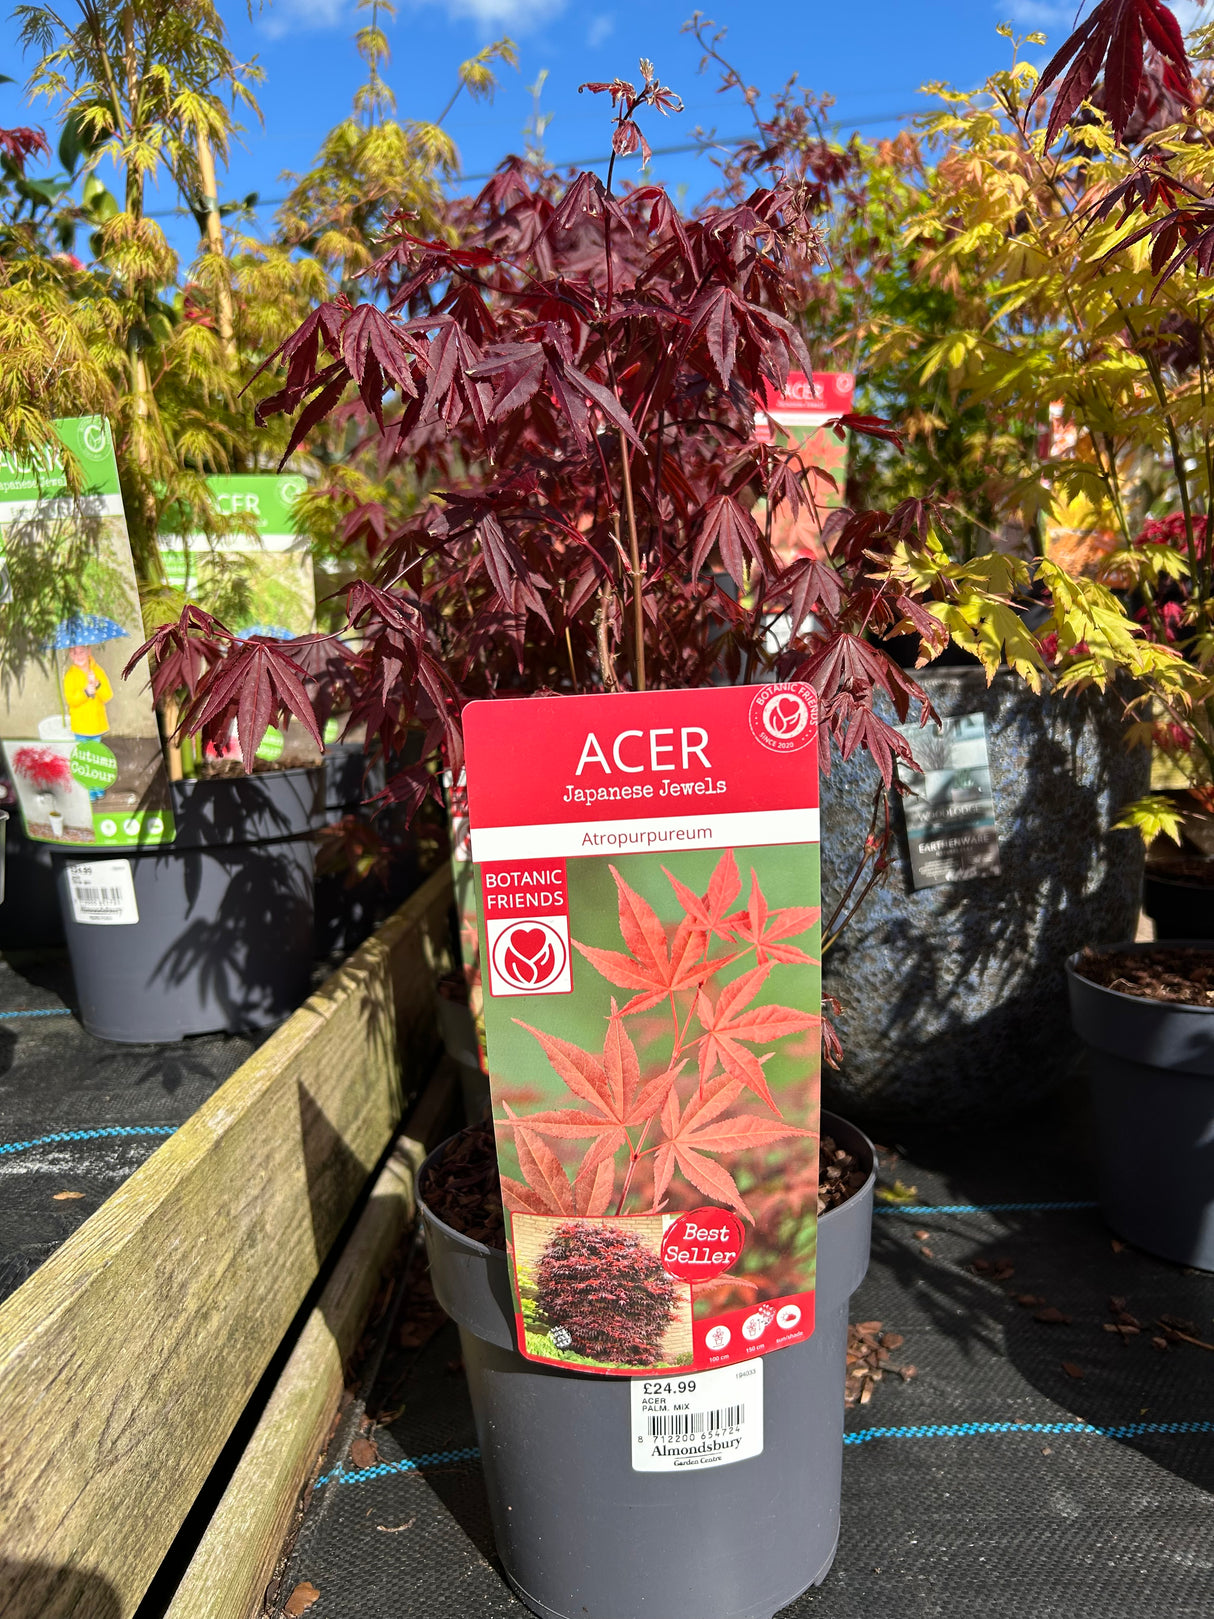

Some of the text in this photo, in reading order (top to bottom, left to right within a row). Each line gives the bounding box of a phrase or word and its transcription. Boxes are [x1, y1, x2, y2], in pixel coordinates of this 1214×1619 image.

[0, 480, 37, 493] apanese
[756, 684, 818, 726] BOTANIC FRIENDS
[760, 732, 776, 747] SINCE
[71, 747, 117, 769] Autumn
[575, 726, 712, 776] ACER
[71, 761, 116, 783] Colour
[563, 777, 727, 806] Japanese Jewels
[581, 827, 713, 848] Atropurpureum
[485, 869, 563, 889] BOTANIC
[487, 891, 564, 910] FRIENDS
[683, 1222, 730, 1242] Best
[664, 1246, 736, 1264] Seller
[643, 1380, 696, 1395] £24.99
[642, 1397, 666, 1405] ACER
[653, 1433, 696, 1443] 712200
[700, 1426, 741, 1440] 654724
[651, 1437, 742, 1457] Almondsbury
[673, 1459, 699, 1467] Garden
